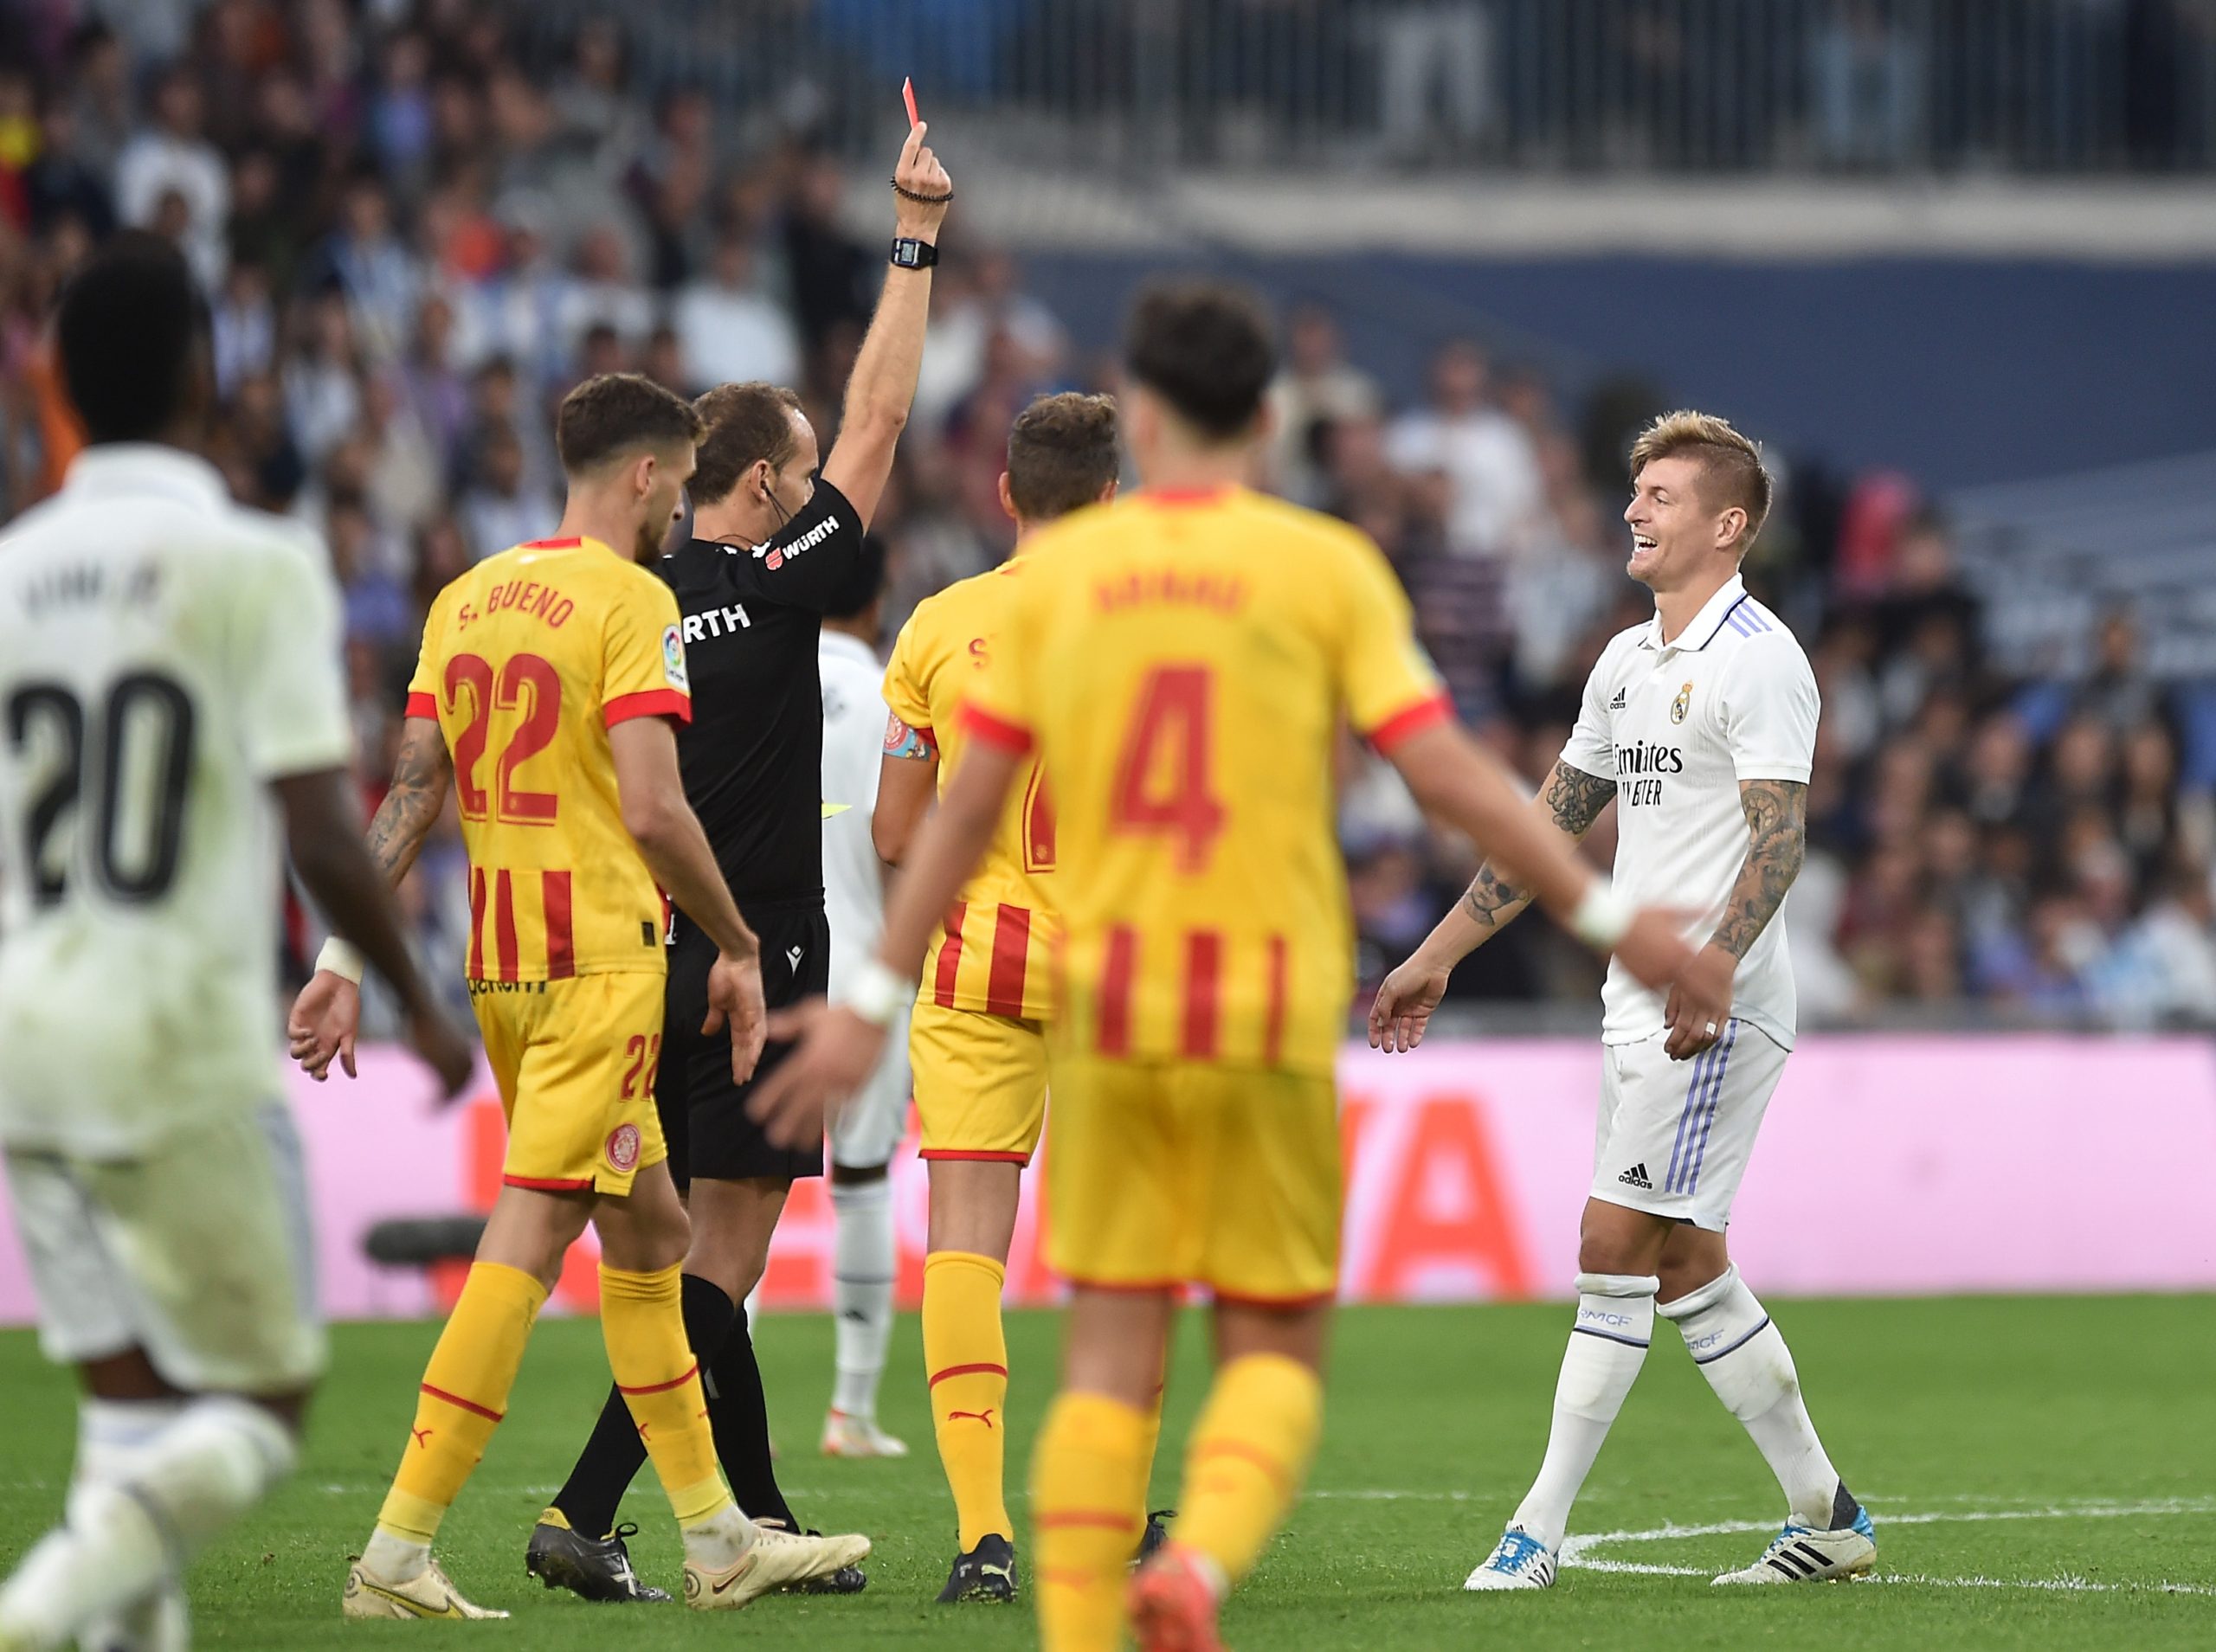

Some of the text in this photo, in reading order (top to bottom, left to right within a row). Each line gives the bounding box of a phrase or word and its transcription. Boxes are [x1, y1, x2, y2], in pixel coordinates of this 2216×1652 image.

[782, 515, 840, 561] WÜRTH
[458, 581, 574, 632] S. BUENO
[682, 603, 751, 644] RTH
[444, 653, 561, 827] 22
[8, 672, 194, 906] 20
[1107, 661, 1230, 876] 4
[1618, 1173, 1653, 1190] adidas
[1579, 1308, 1633, 1327] RMCF
